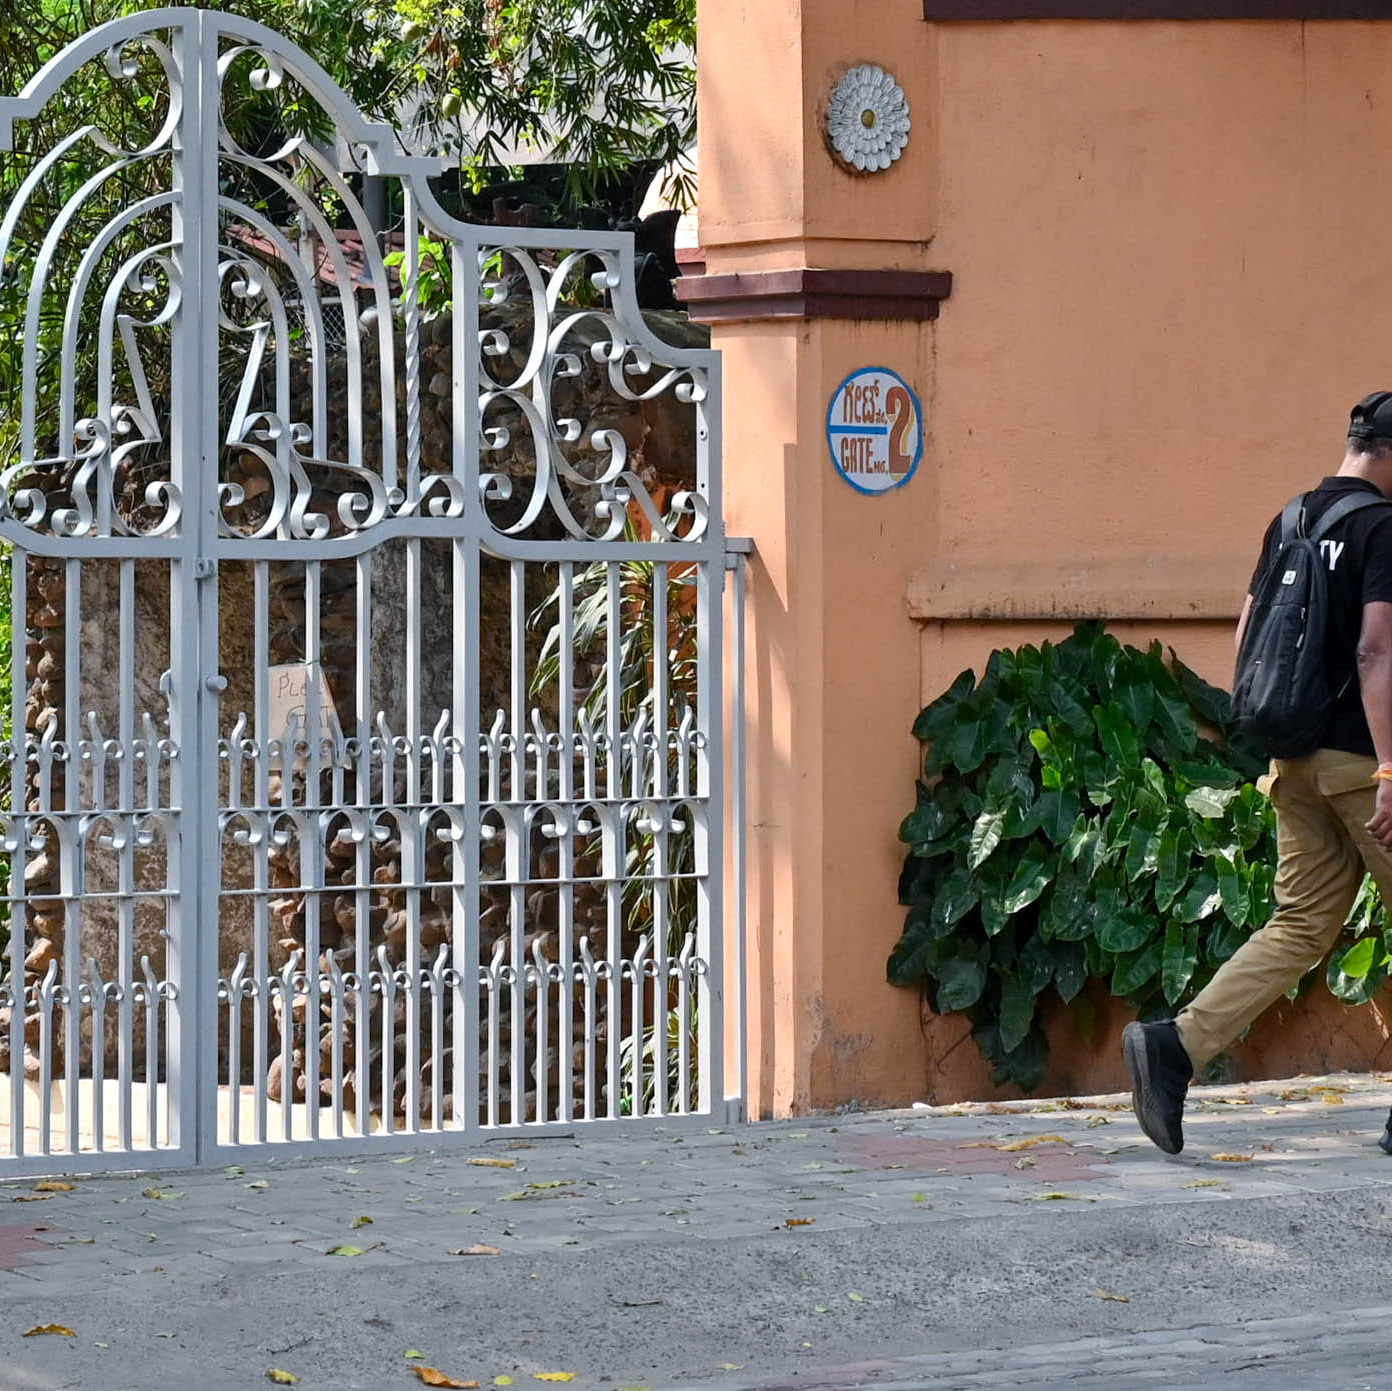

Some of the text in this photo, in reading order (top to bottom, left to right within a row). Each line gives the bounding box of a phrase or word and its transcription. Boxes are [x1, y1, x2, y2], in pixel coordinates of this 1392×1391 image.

[843, 379, 880, 424] ಗೇಟ್
[885, 386, 911, 474] 2
[841, 437, 873, 474] GATE
